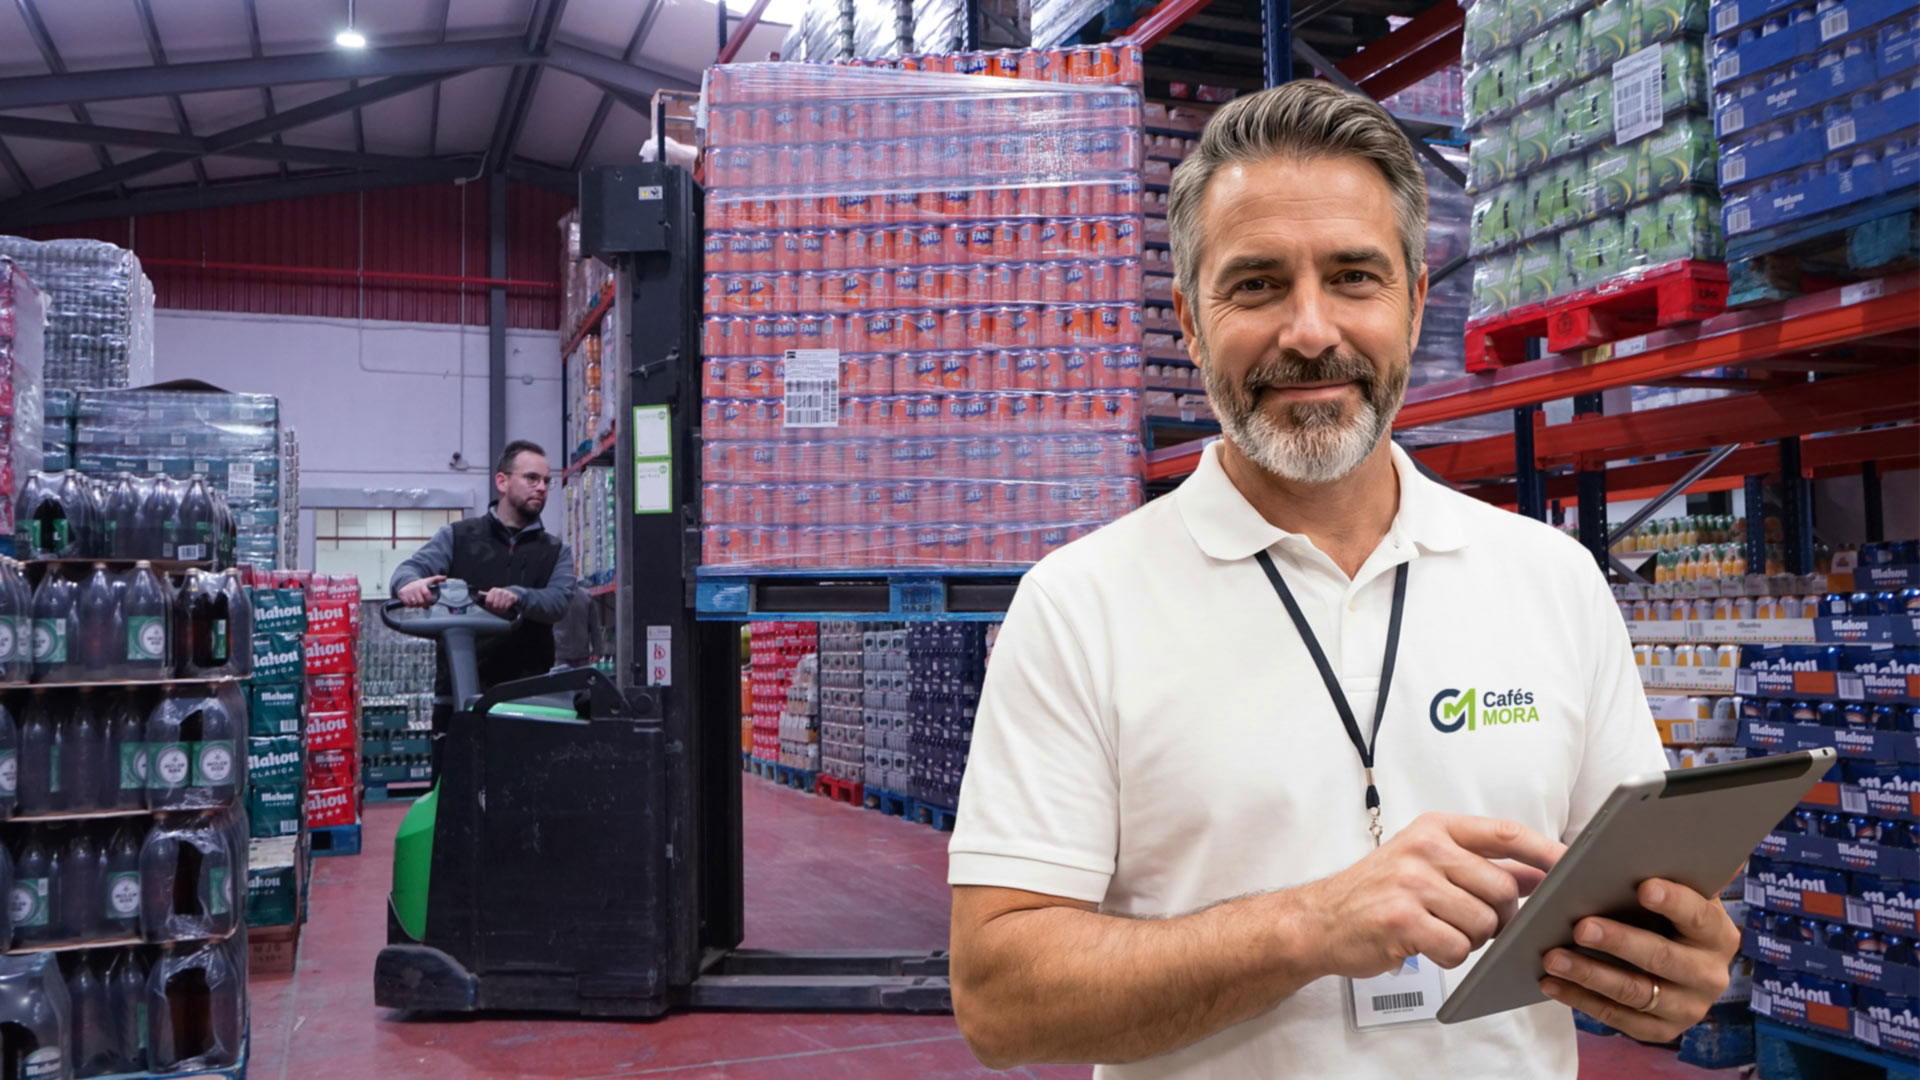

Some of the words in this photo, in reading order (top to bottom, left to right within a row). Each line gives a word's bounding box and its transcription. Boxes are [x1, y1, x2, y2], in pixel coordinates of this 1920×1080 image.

[1871, 568, 1908, 579] Mahou
[306, 607, 344, 621] ahou
[1831, 619, 1868, 630] Mahou
[306, 642, 345, 658] ahou
[1758, 671, 1793, 683] Mahou
[1864, 675, 1906, 688] Mahou
[1483, 689, 1534, 708] Cafés
[1483, 706, 1539, 726] MORA
[307, 718, 347, 734] ahou
[1750, 723, 1785, 736] Mahou
[1835, 730, 1874, 744] Mahou
[307, 793, 348, 811] ahou
[1867, 789, 1909, 805] Mahou
[1837, 842, 1878, 860] Mahou
[248, 876, 281, 888] ahou
[1766, 885, 1801, 901] Mahou
[1873, 904, 1915, 922] Mahou
[1842, 955, 1882, 974] Mahou
